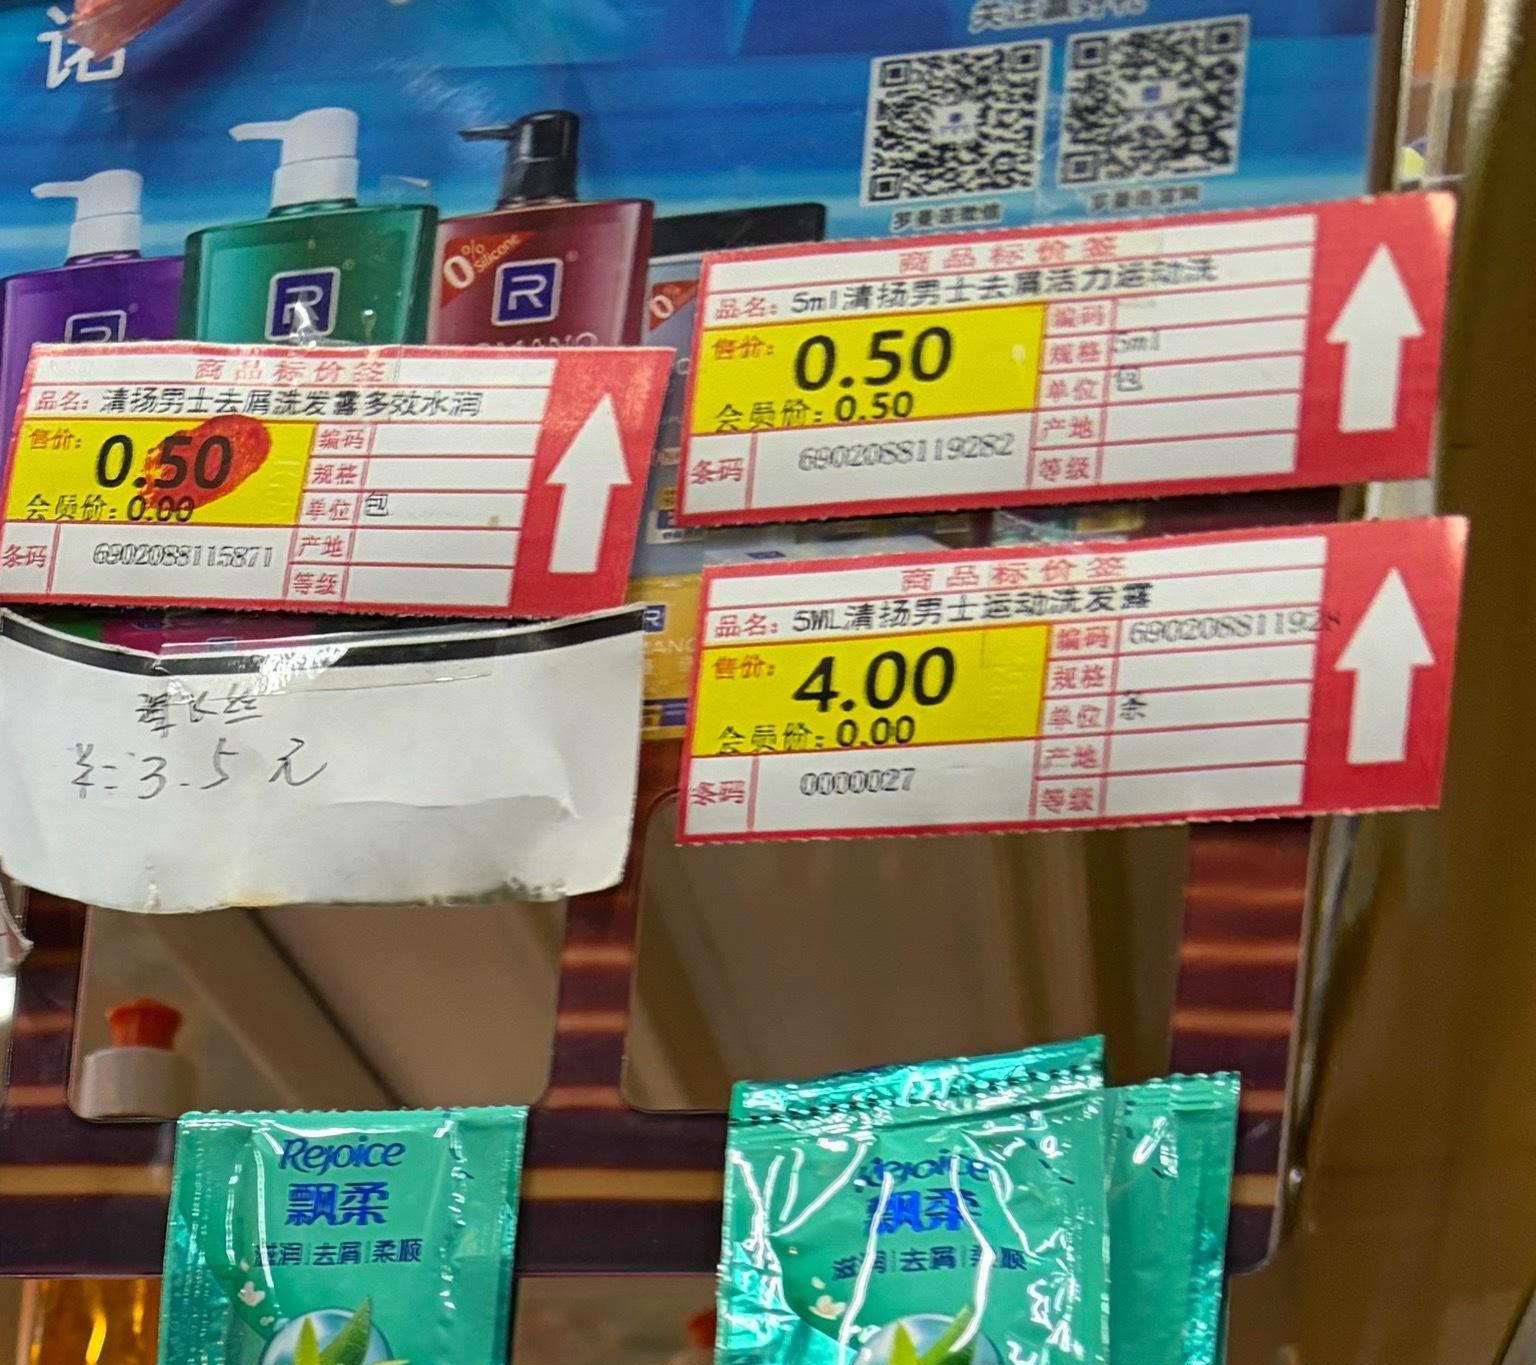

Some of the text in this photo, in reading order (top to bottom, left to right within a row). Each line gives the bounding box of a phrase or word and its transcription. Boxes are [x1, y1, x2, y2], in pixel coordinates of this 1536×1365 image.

[793, 326, 953, 392] 0.50
[834, 390, 914, 423] 0.50
[95, 434, 234, 490] 0.50
[127, 494, 196, 523] 0.00
[366, 490, 390, 518] 包
[900, 556, 1125, 591] 商品标价签
[792, 645, 956, 714] 4.00
[835, 714, 915, 749] 0.00
[278, 1136, 407, 1173] Rejoice
[284, 1181, 390, 1227] 飘柔
